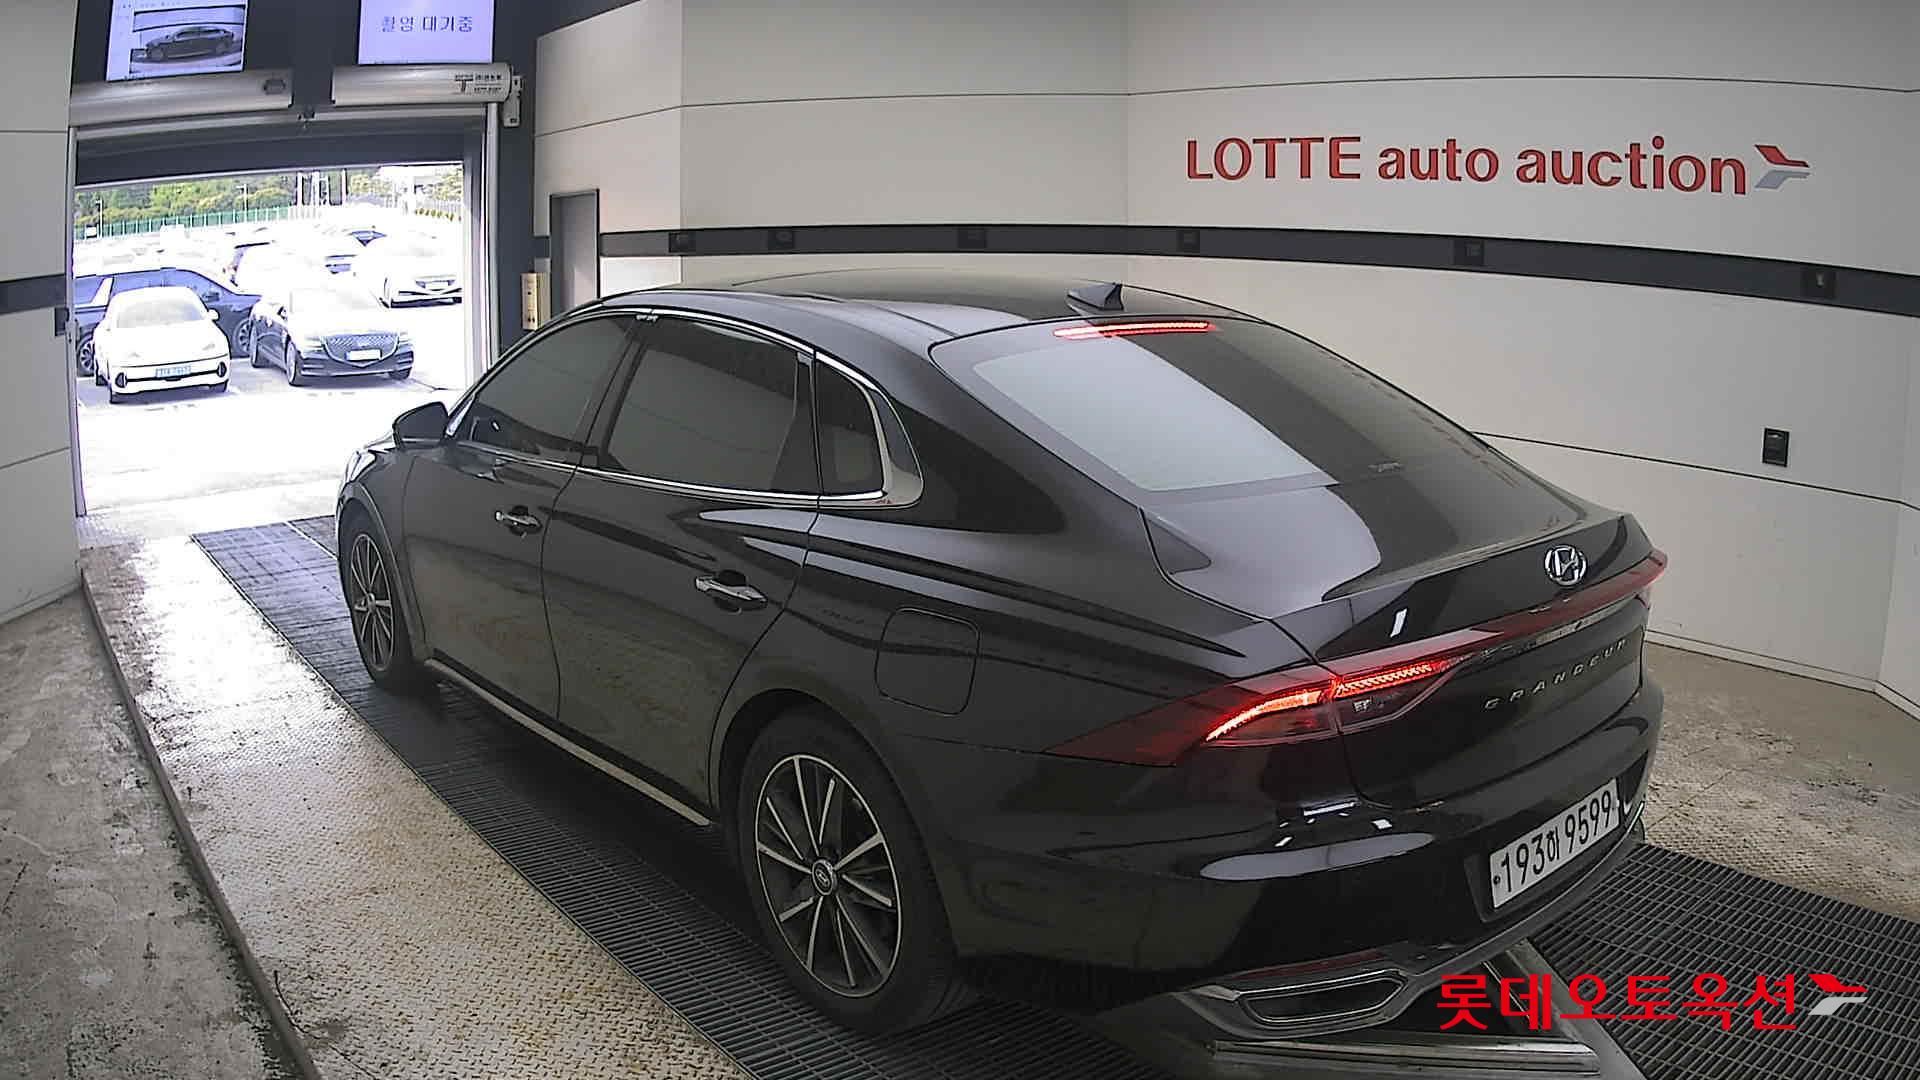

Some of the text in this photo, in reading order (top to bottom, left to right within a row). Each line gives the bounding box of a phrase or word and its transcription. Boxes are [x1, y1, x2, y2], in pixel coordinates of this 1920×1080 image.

[423, 15, 473, 32] 대기중
[1187, 135, 1746, 195] LOTTE auto auction
[1484, 638, 1627, 710] GRANDEUR
[1501, 790, 1612, 893] 193하 9599
